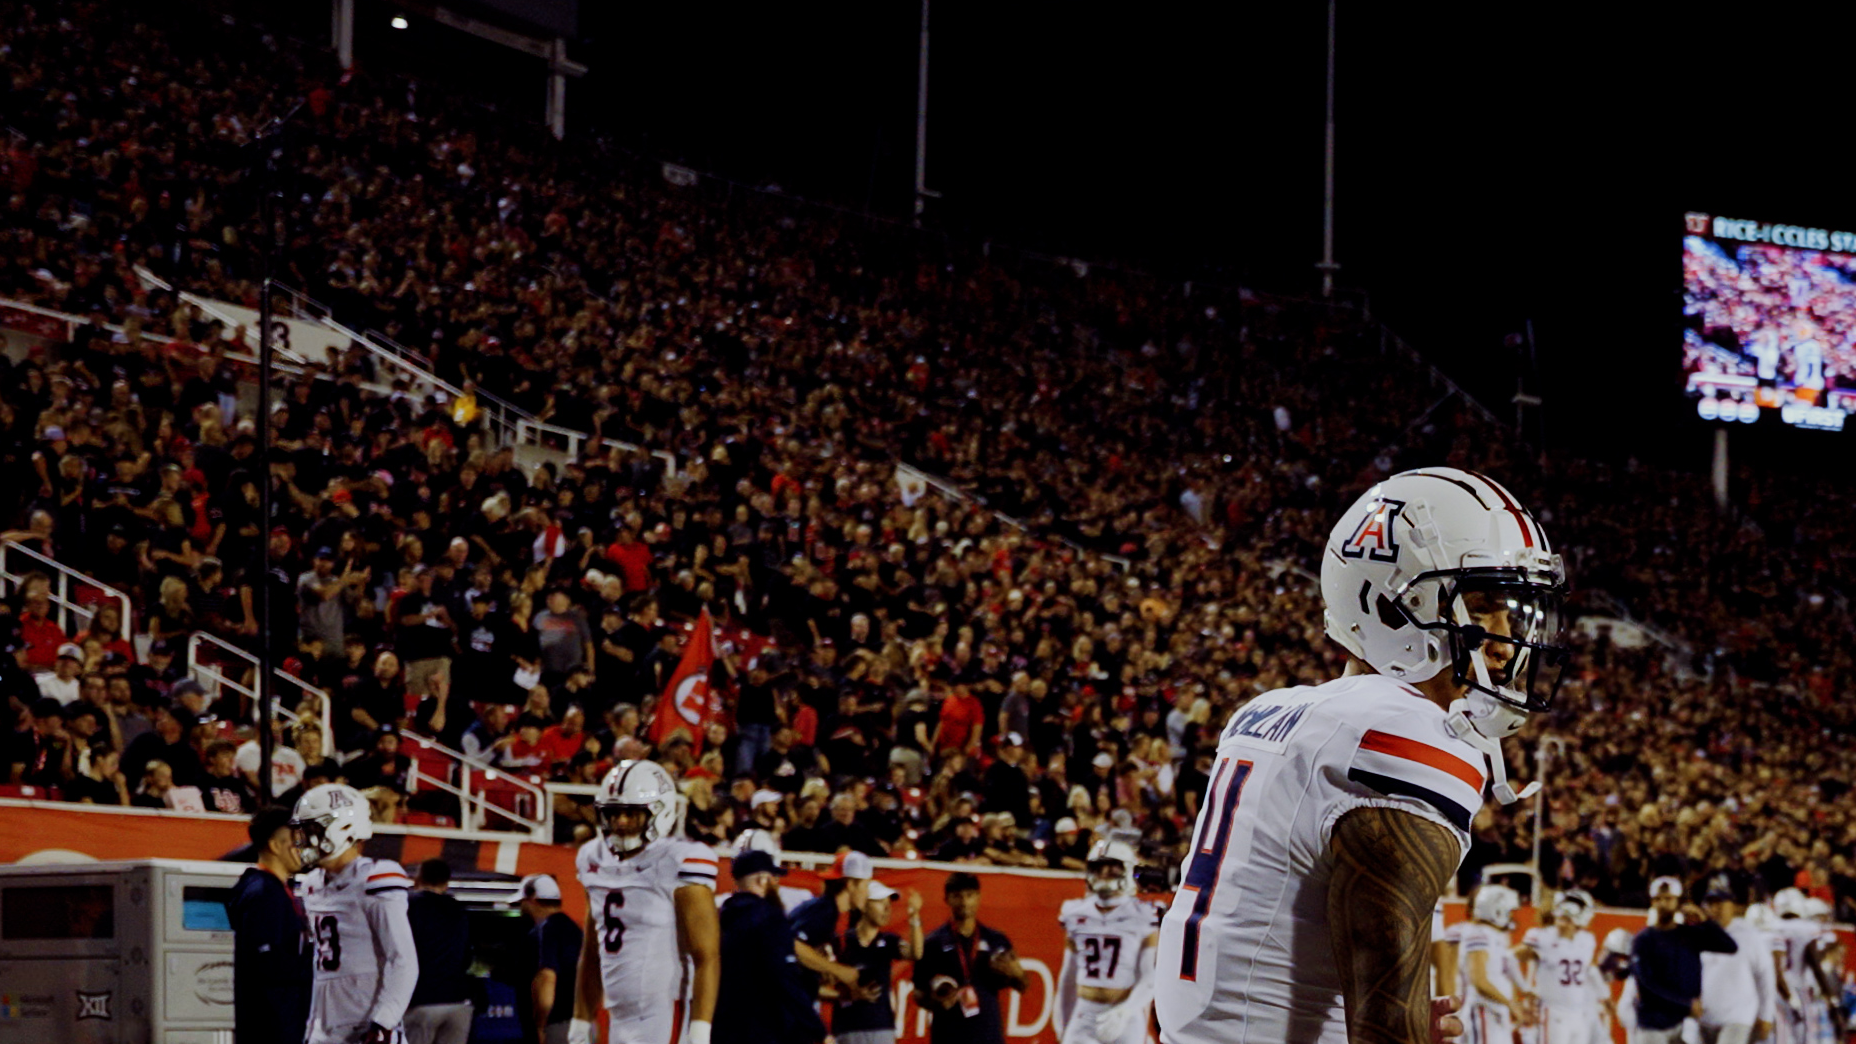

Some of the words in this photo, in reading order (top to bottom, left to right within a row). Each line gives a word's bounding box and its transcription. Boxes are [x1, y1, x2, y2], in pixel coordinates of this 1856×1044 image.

[1342, 498, 1406, 563] A
[1180, 757, 1254, 982] 4
[603, 888, 626, 954] 6
[1084, 937, 1121, 979] 27
[1558, 959, 1583, 986] 32
